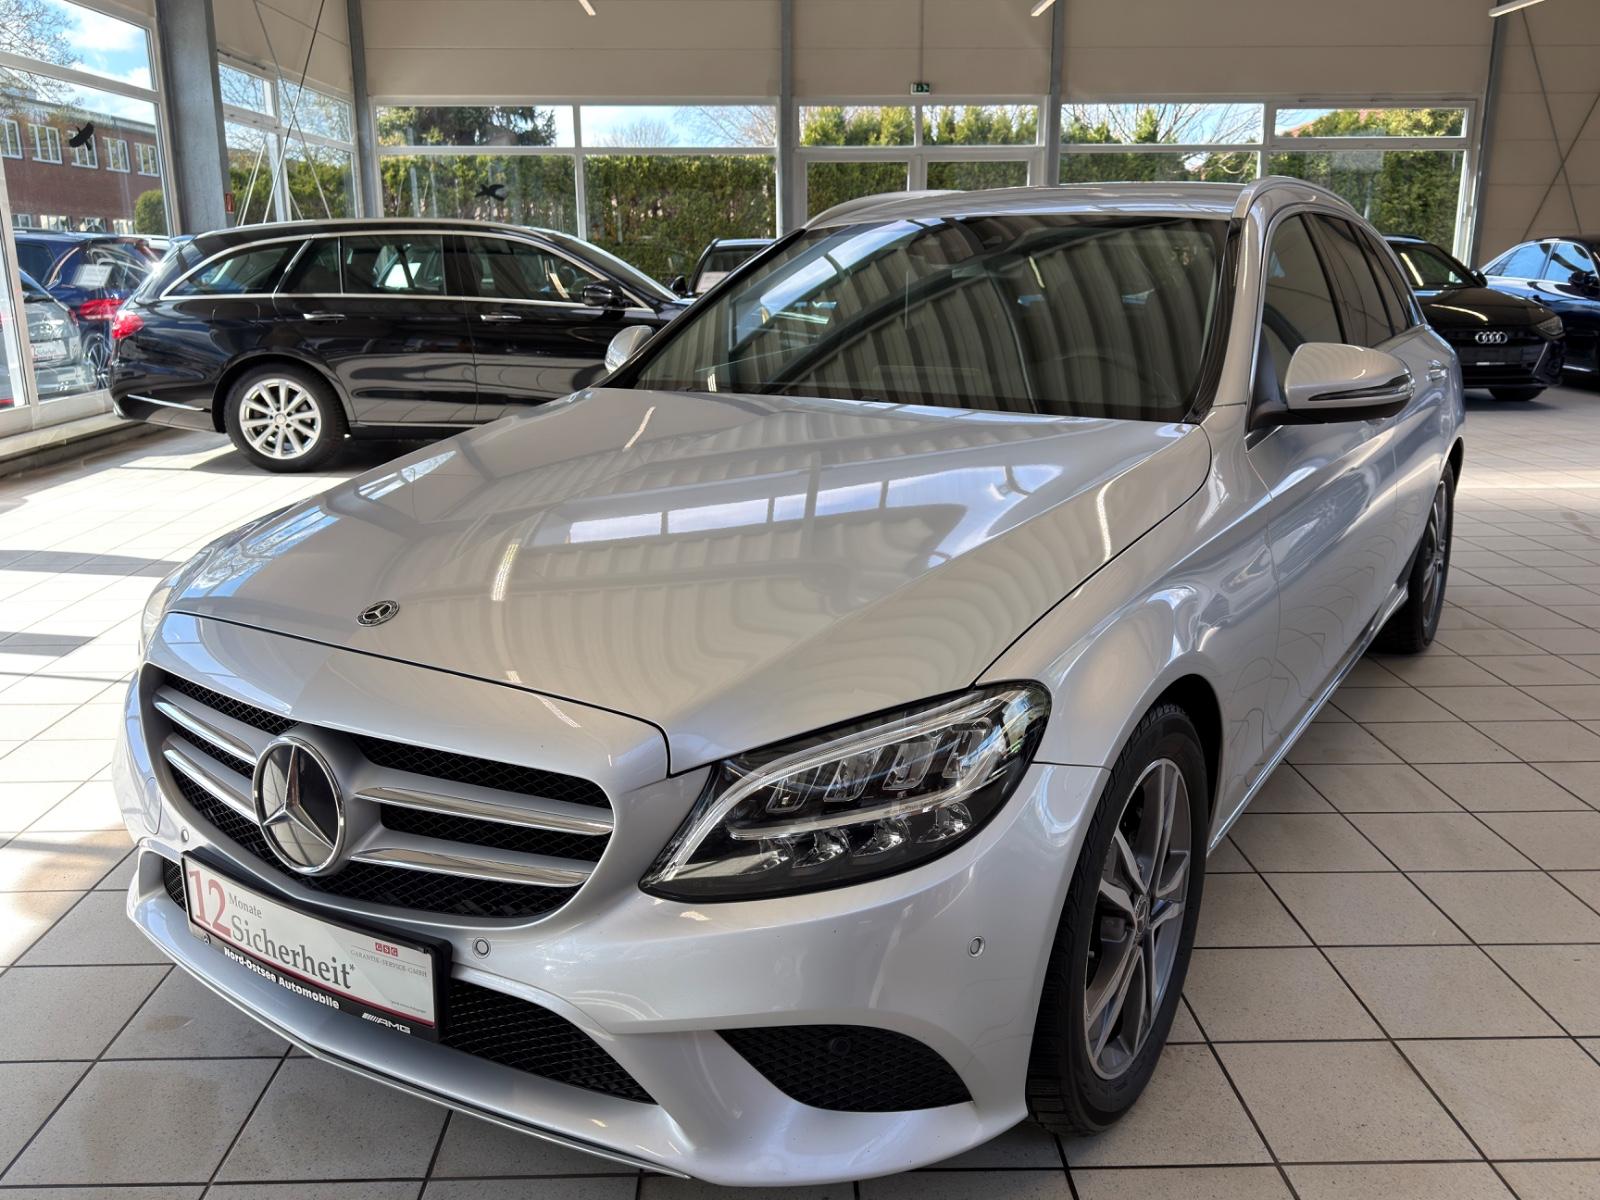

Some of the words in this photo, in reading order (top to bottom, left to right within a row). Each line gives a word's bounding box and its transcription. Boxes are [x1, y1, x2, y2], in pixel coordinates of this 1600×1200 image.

[189, 870, 232, 938] 12
[228, 892, 263, 919] Monate
[223, 946, 277, 983] Nord-Ostsee
[278, 976, 340, 1010] Automobile
